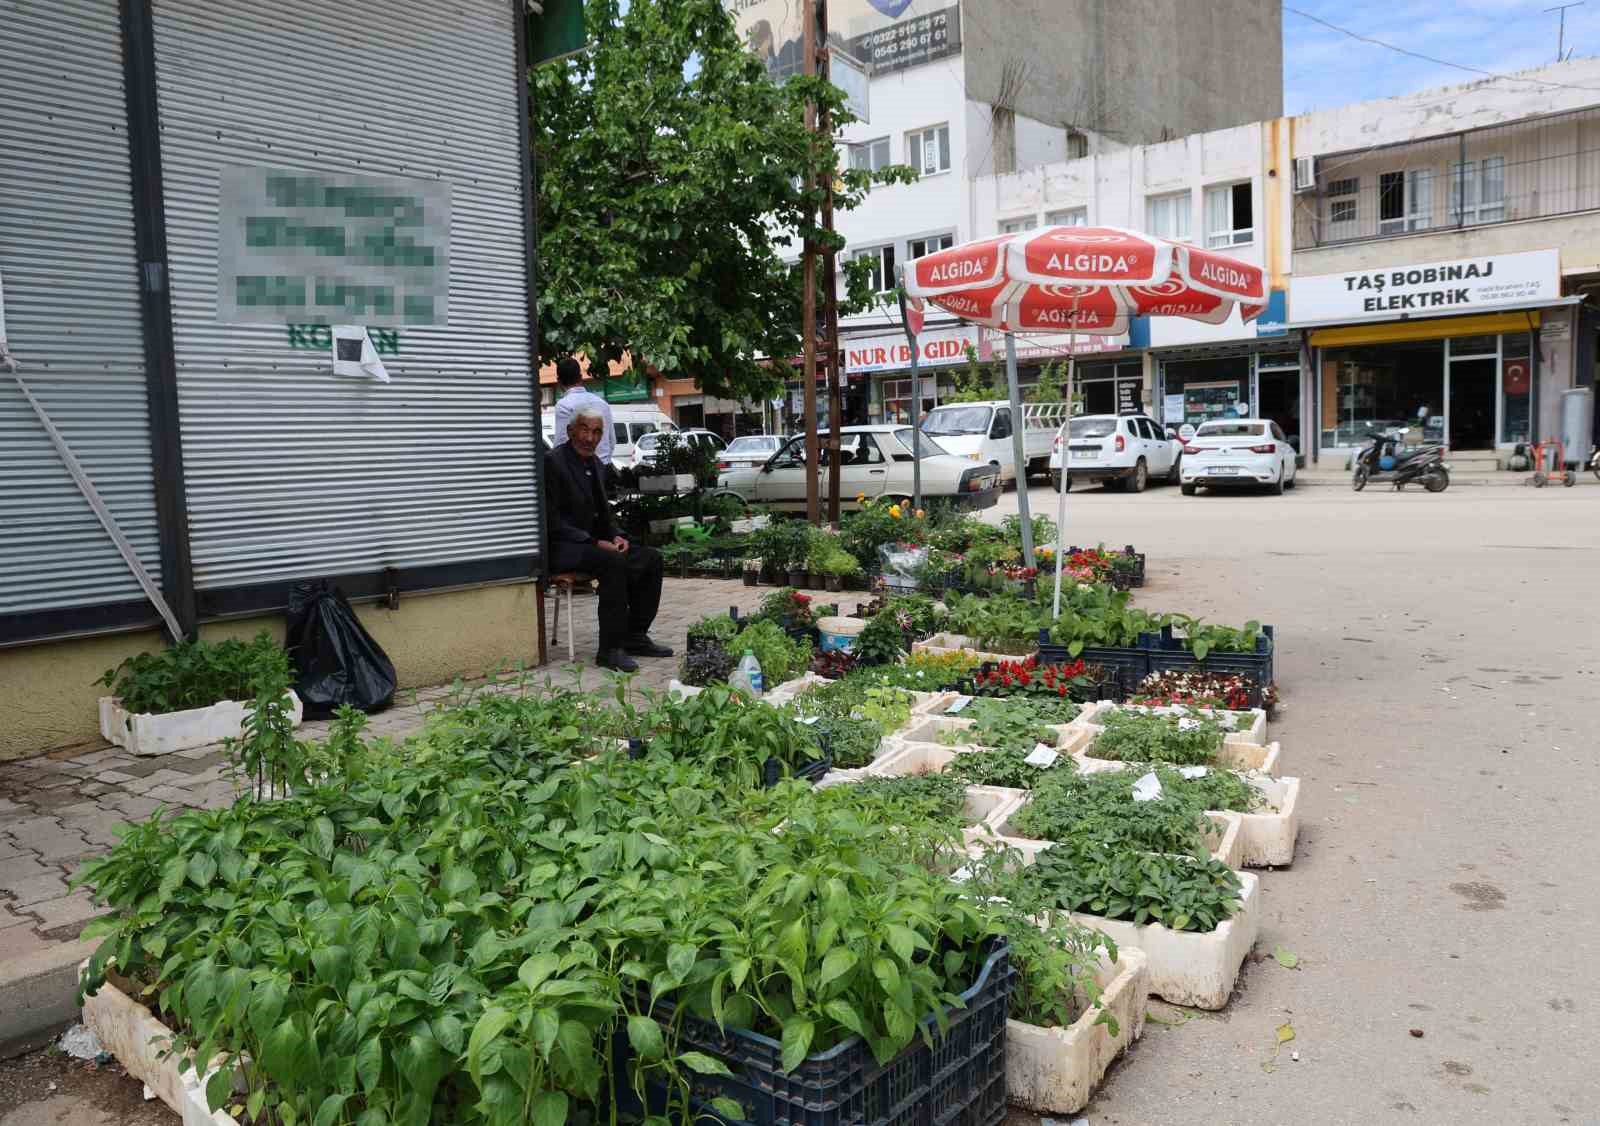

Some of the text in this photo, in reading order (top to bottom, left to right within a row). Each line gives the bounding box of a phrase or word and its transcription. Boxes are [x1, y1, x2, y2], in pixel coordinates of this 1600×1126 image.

[1344, 273, 1385, 293] TAŞ
[849, 347, 887, 367] NUR
[924, 338, 975, 359] GIDA
